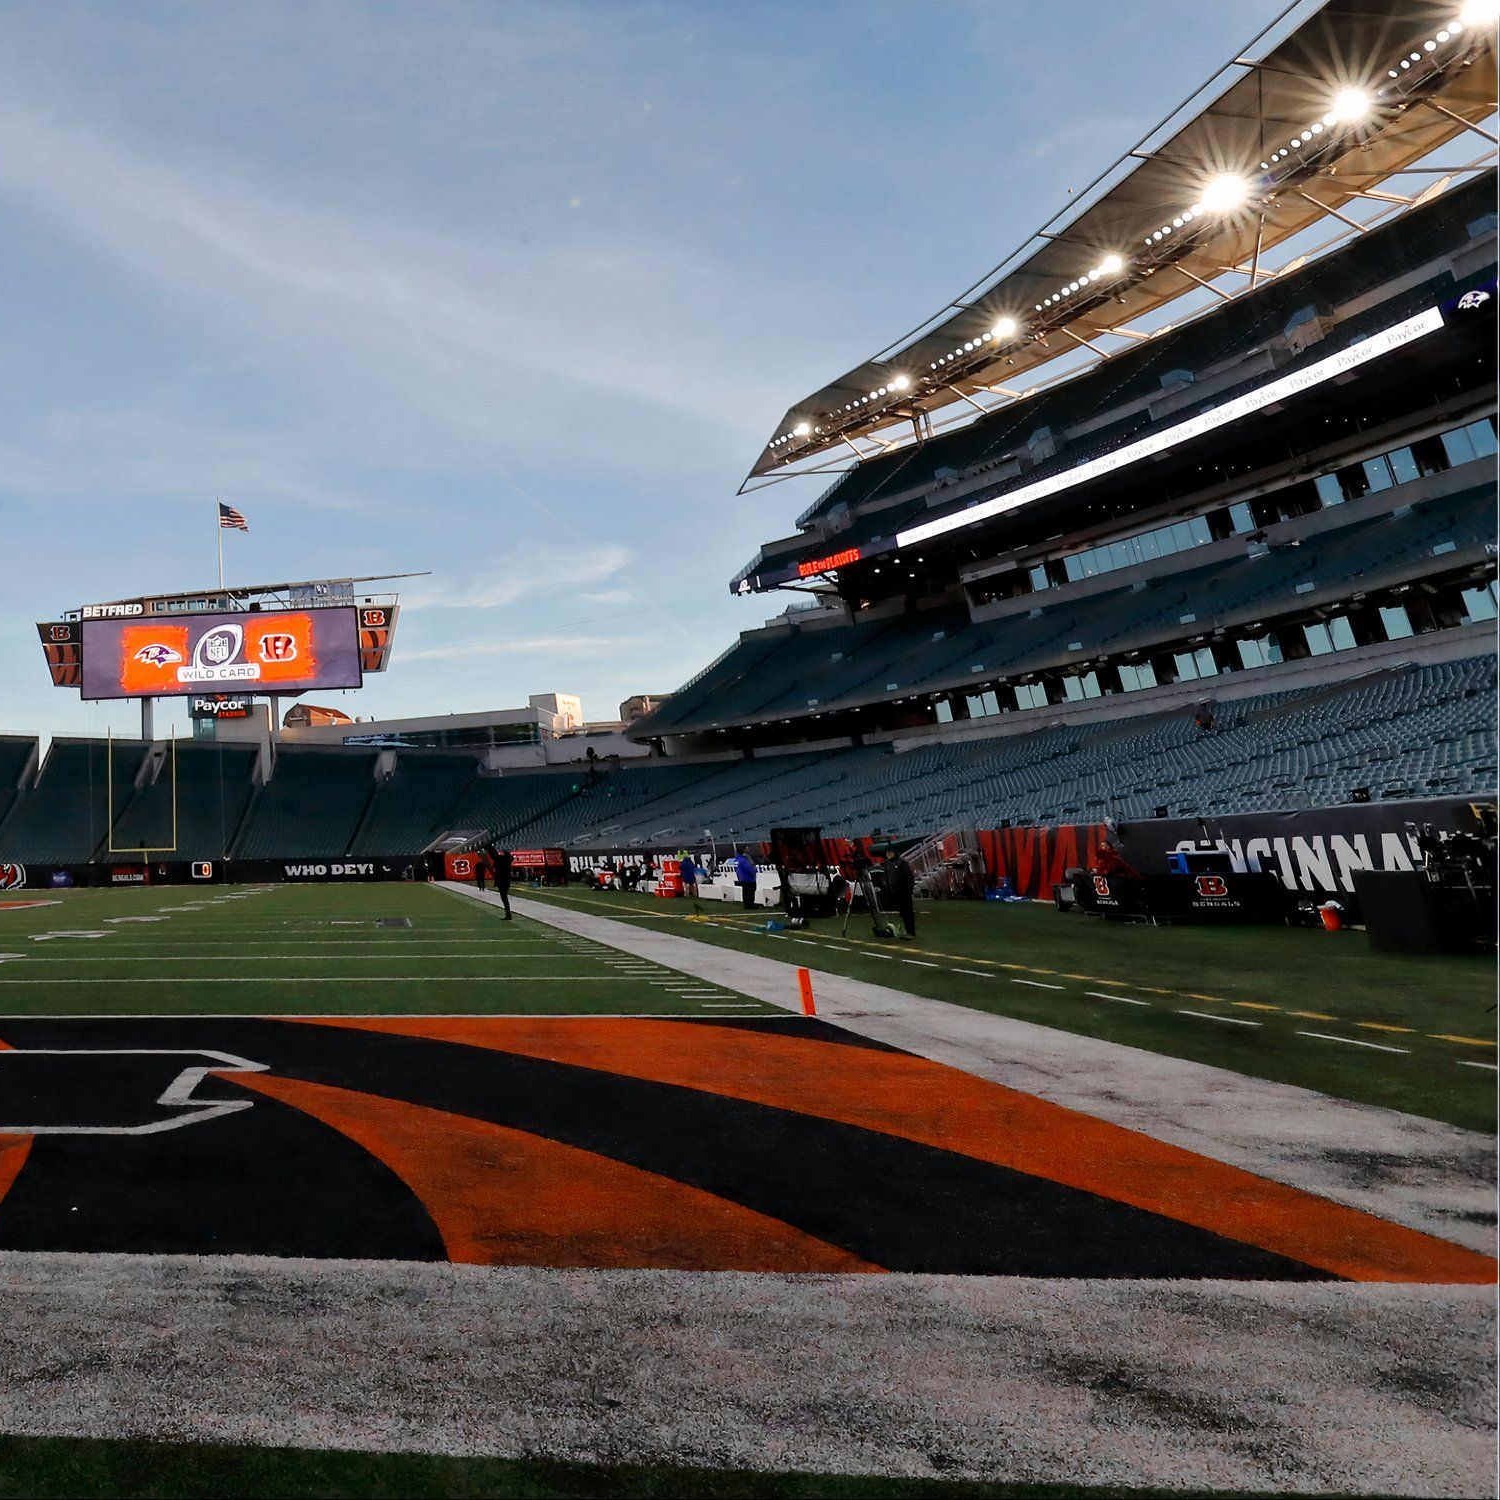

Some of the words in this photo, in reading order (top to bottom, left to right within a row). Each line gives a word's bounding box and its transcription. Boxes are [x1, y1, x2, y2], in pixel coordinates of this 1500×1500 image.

[1289, 369, 1325, 390] Paycor
[1337, 346, 1373, 368] Paycor
[1387, 321, 1427, 345] Paycor
[83, 603, 143, 618] BETFRED
[210, 648, 226, 659] NFL
[183, 669, 215, 679] WILD
[220, 667, 256, 678] CARD
[194, 699, 246, 714] Paycor
[285, 864, 326, 877] WHO
[331, 863, 374, 876] DEY!
